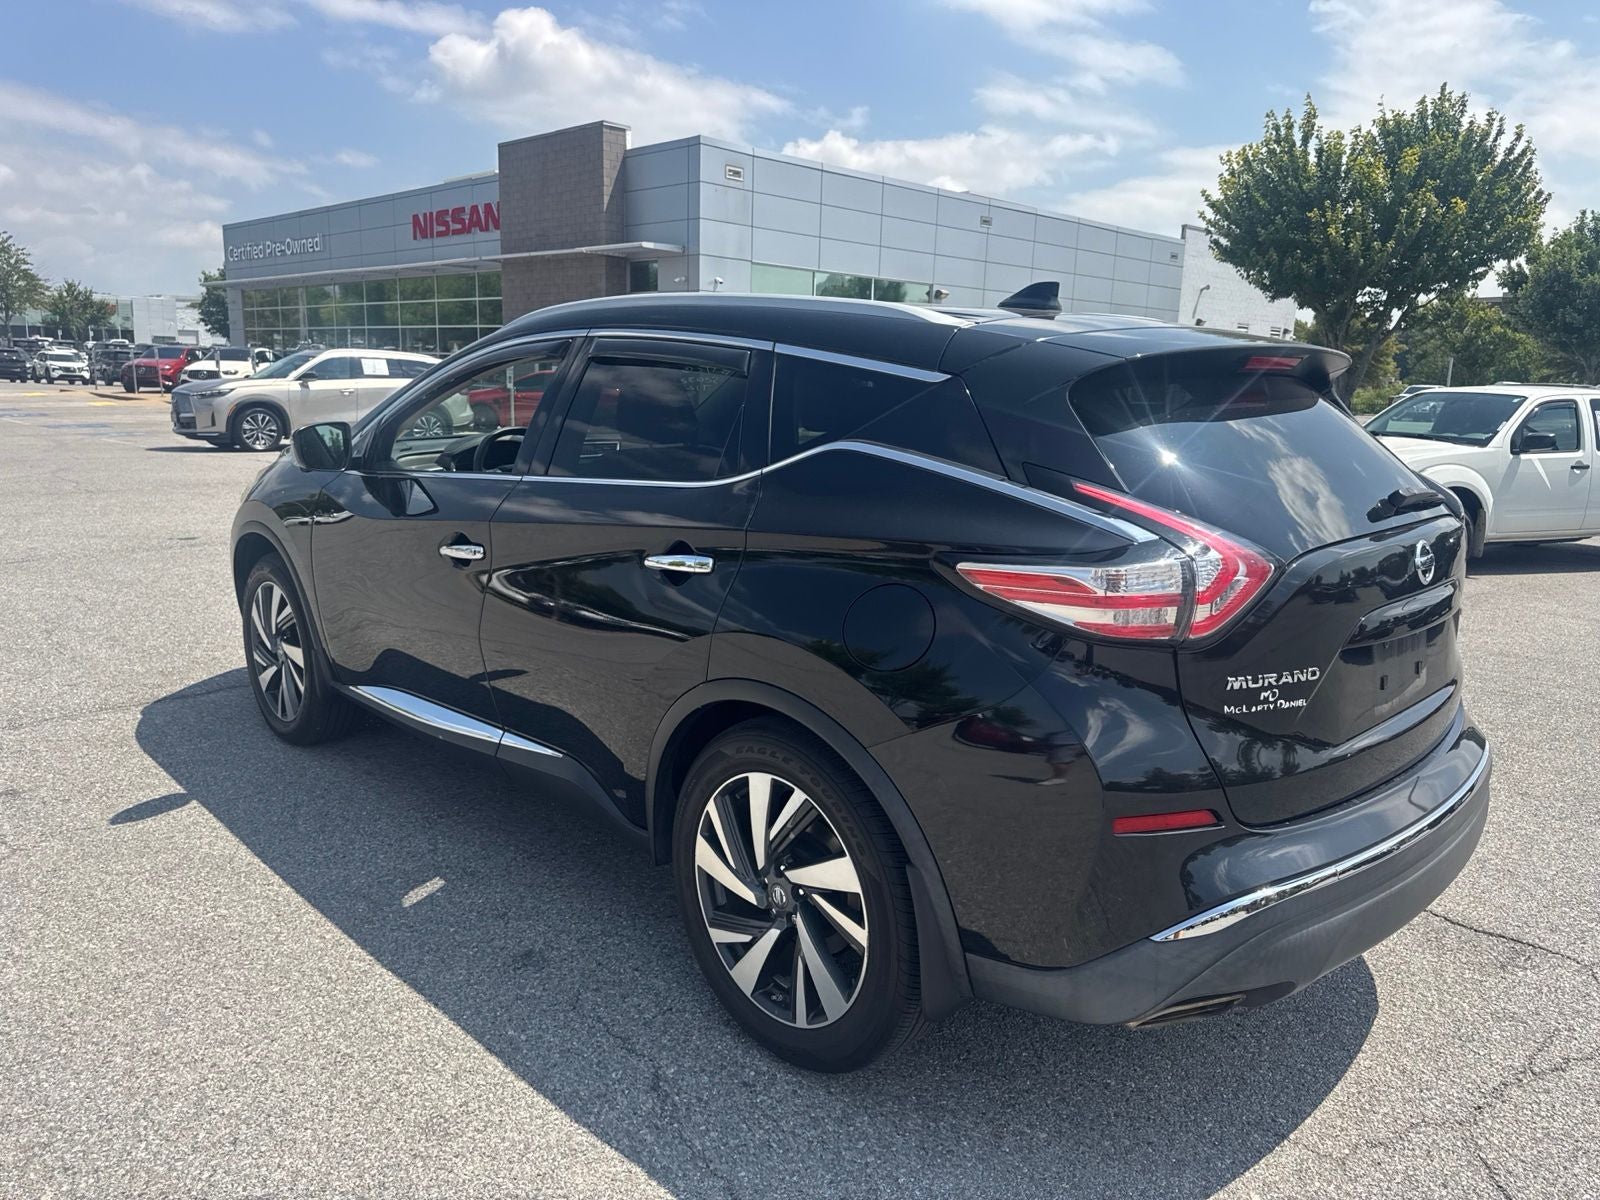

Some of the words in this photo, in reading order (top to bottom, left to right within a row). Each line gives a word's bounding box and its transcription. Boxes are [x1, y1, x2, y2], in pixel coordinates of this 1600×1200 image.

[412, 201, 500, 240] NISSAN
[228, 241, 264, 262] Certified
[265, 232, 322, 257] Pre-Owned
